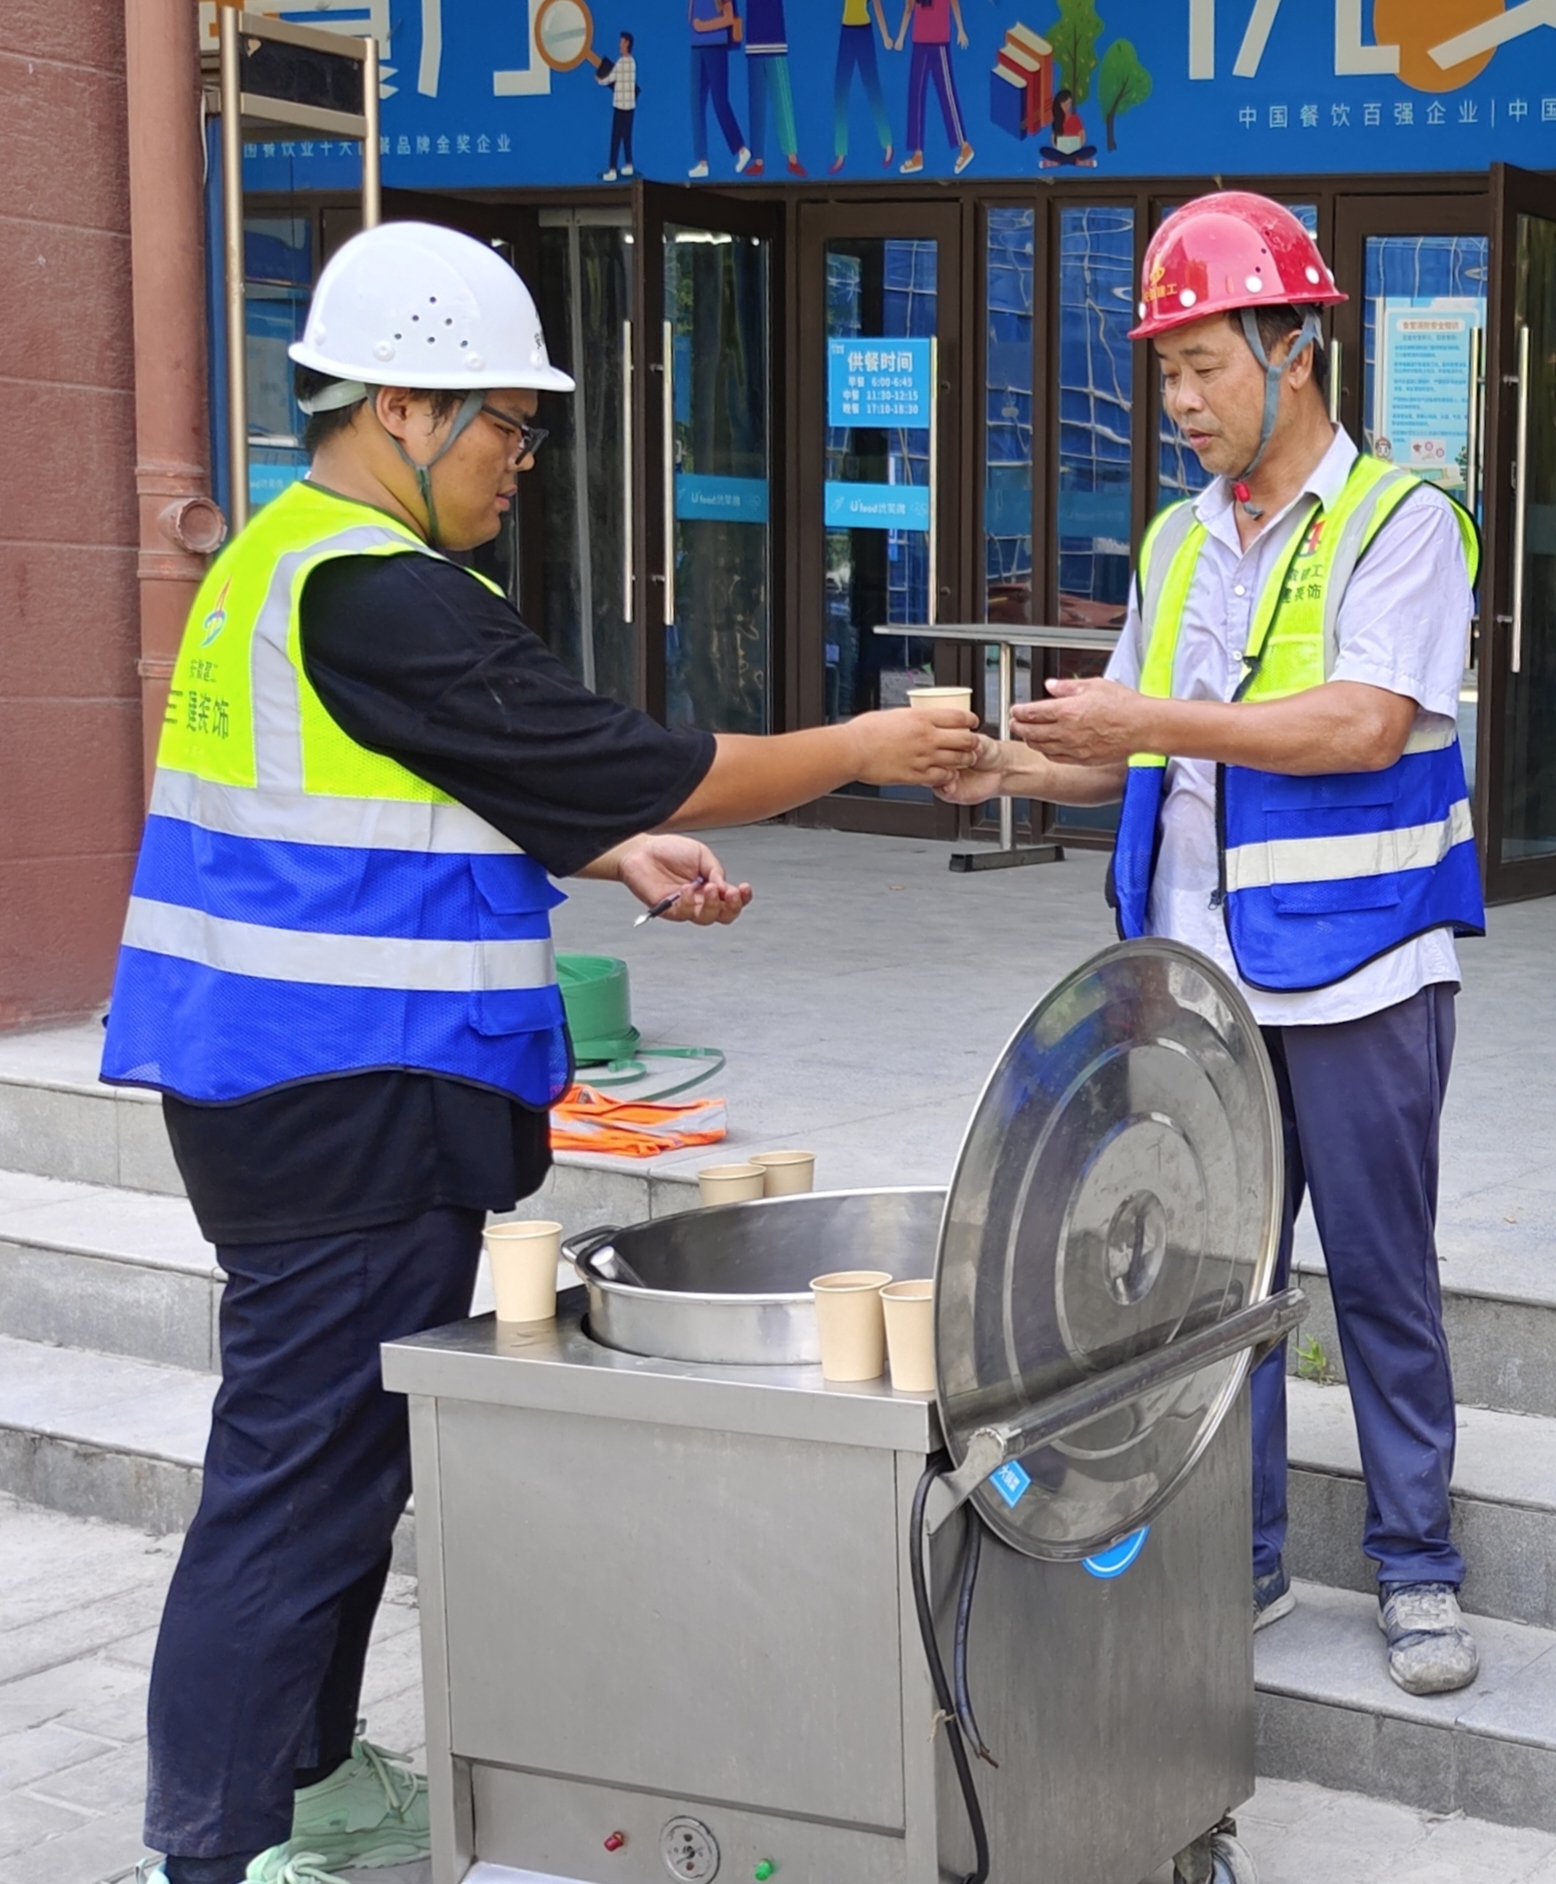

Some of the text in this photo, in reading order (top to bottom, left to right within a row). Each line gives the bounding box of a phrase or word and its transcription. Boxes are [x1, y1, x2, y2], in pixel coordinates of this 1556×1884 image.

[1238, 99, 1479, 128] 中国餐饮百强企业
[848, 351, 913, 373] 供餐时间
